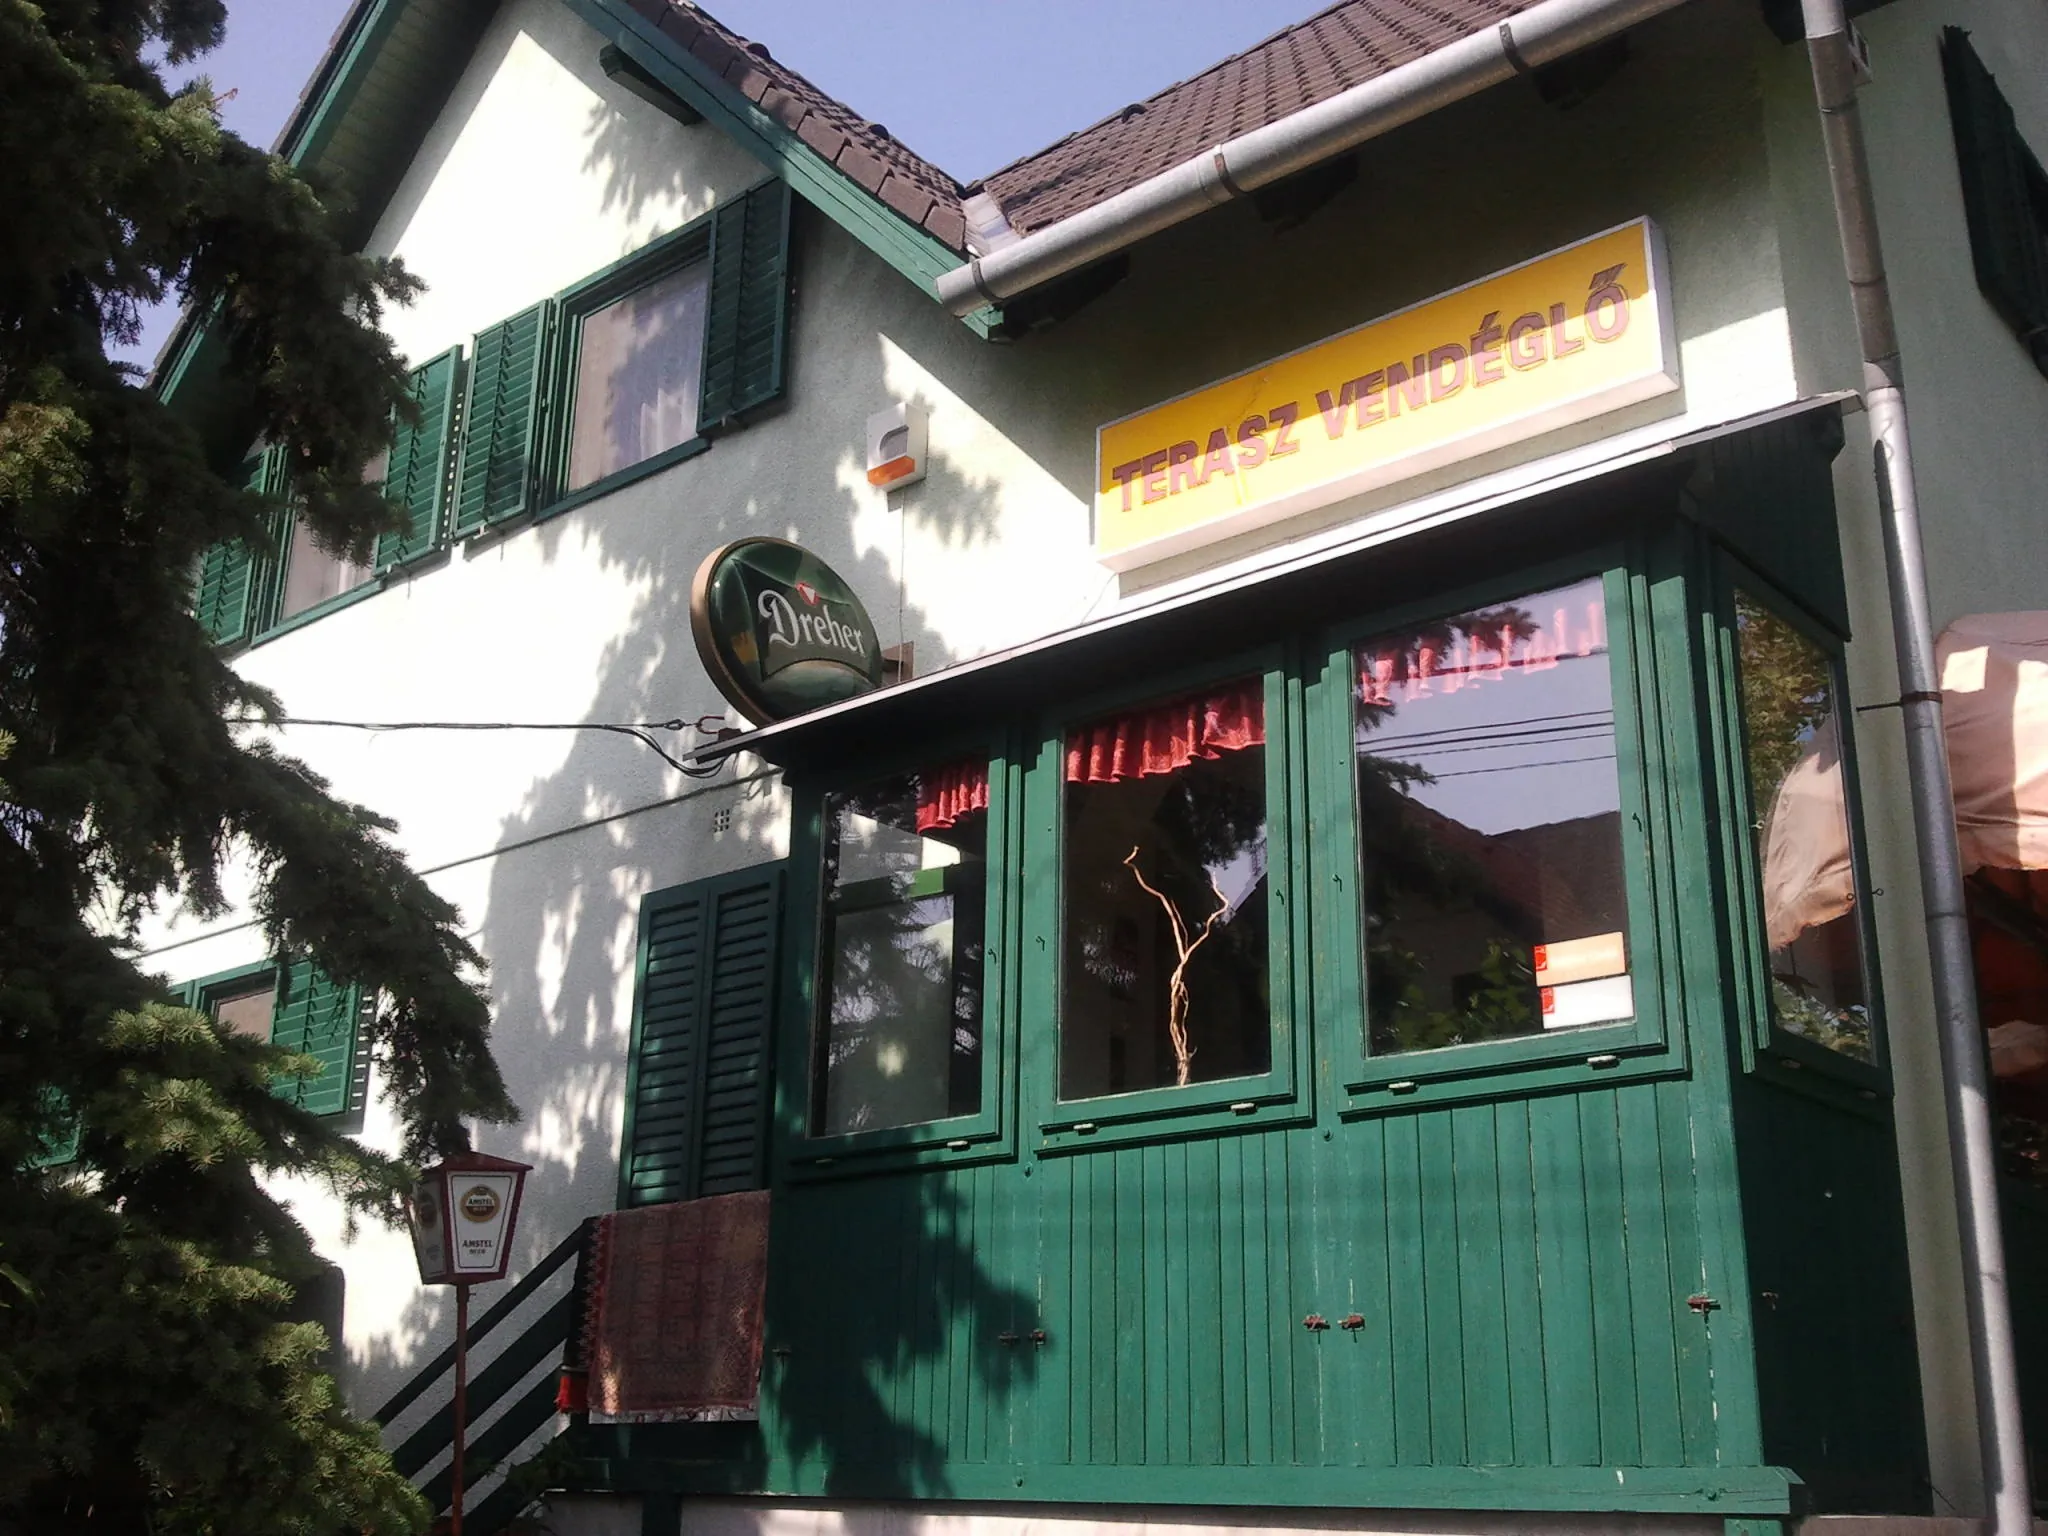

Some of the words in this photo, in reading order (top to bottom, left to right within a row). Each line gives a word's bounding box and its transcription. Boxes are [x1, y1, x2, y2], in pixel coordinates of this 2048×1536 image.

[1111, 401, 1300, 512] TERASZ
[1314, 262, 1631, 441] VENDÉGLŐ
[757, 589, 866, 658] Dreher
[462, 1239, 493, 1248] AMSTEL
